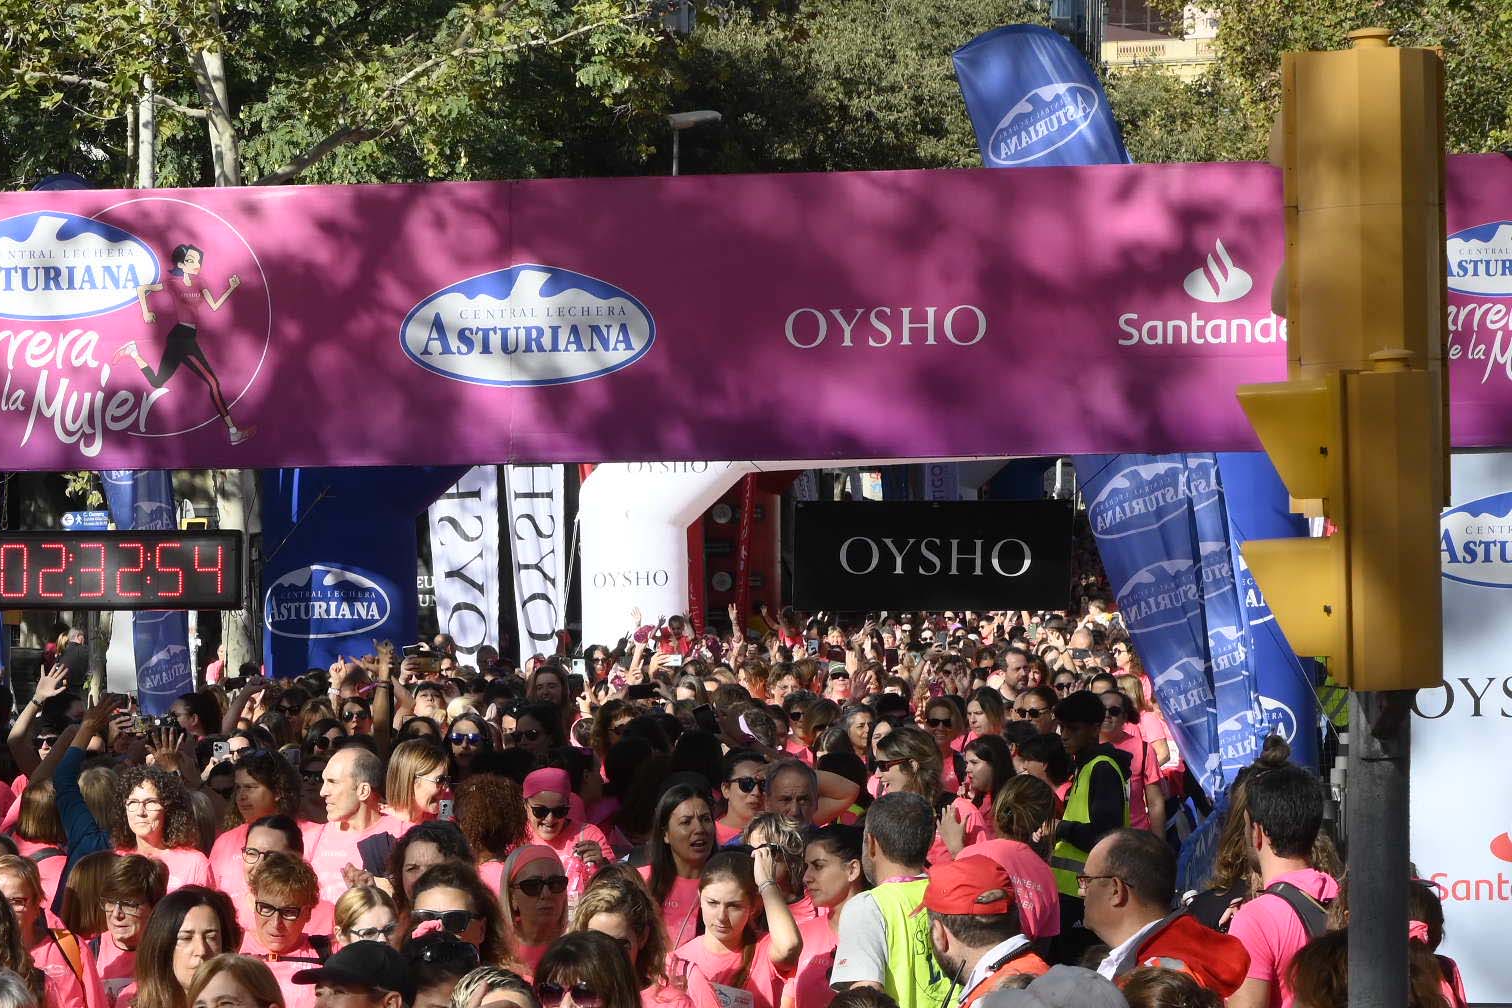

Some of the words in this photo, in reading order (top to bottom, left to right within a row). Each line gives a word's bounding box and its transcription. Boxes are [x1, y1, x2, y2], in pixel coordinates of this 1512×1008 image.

[62, 246, 137, 259] LECHERA
[459, 307, 537, 321] CENTRAL
[546, 305, 627, 317] LECHERA
[784, 305, 988, 349] OYSHO
[419, 311, 636, 356] ASTURIANA
[1468, 332, 1487, 360] la
[0, 370, 26, 412] la
[20, 364, 171, 458] Mujer
[0, 543, 225, 598] 02:32:54
[839, 536, 1033, 578] OYSHO
[593, 568, 669, 590] OYSHO
[276, 590, 325, 600] CENTRAL
[327, 589, 377, 599] LECHERA
[268, 600, 381, 623] ASTURIANA
